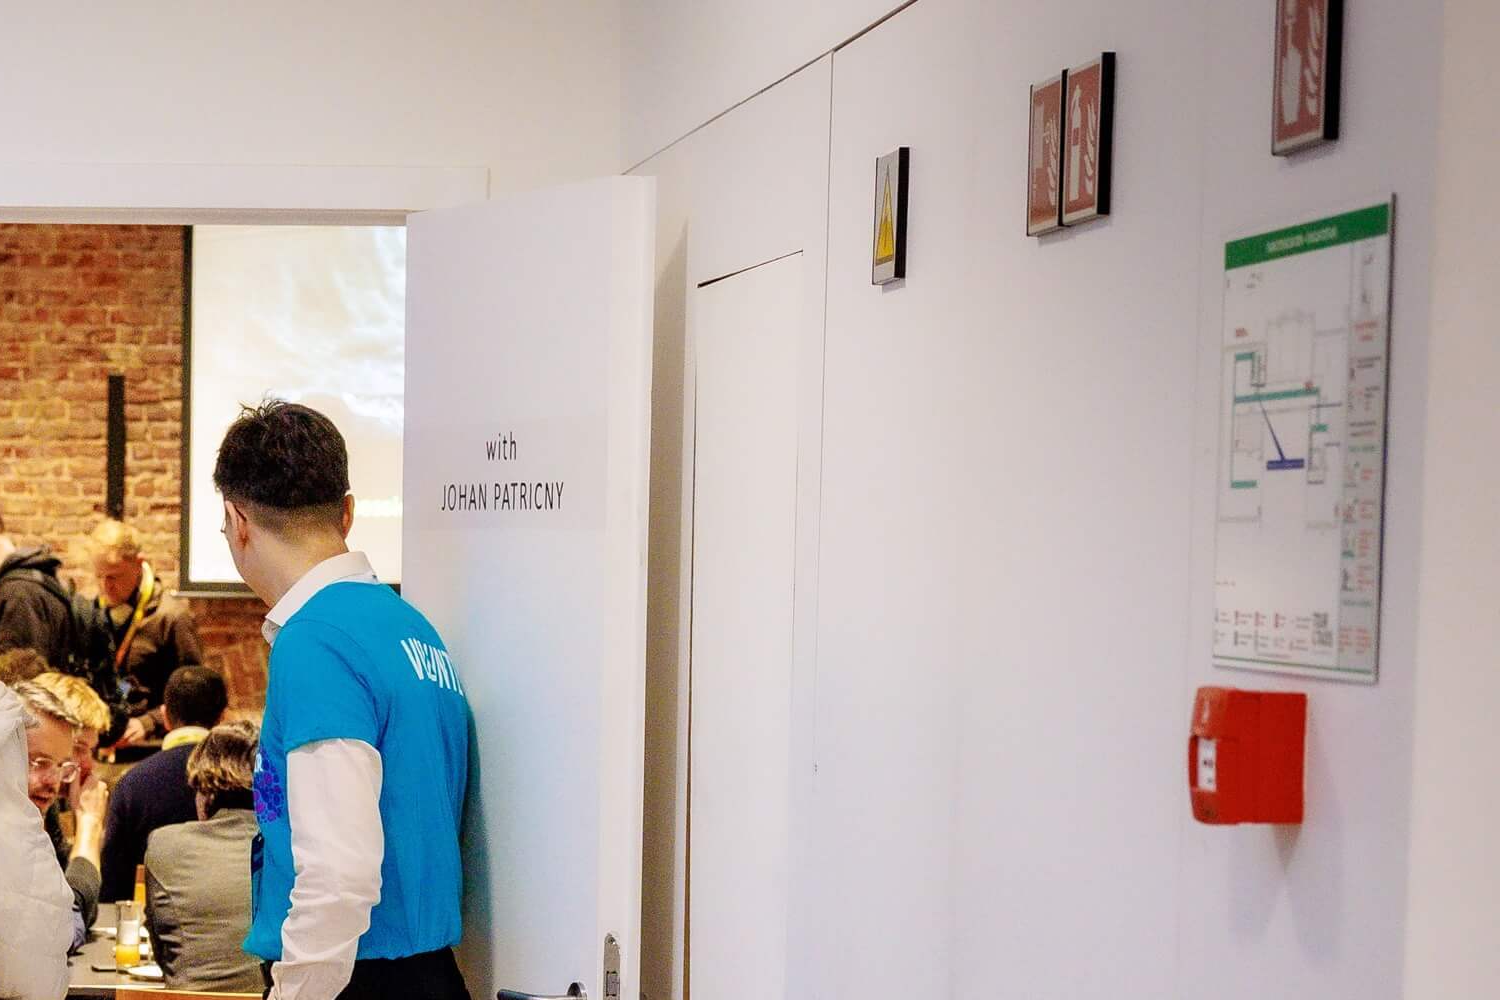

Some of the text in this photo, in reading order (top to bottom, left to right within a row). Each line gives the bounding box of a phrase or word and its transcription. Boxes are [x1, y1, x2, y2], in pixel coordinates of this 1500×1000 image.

[485, 431, 517, 461] with
[441, 481, 564, 512] JOHAN PATRICNY
